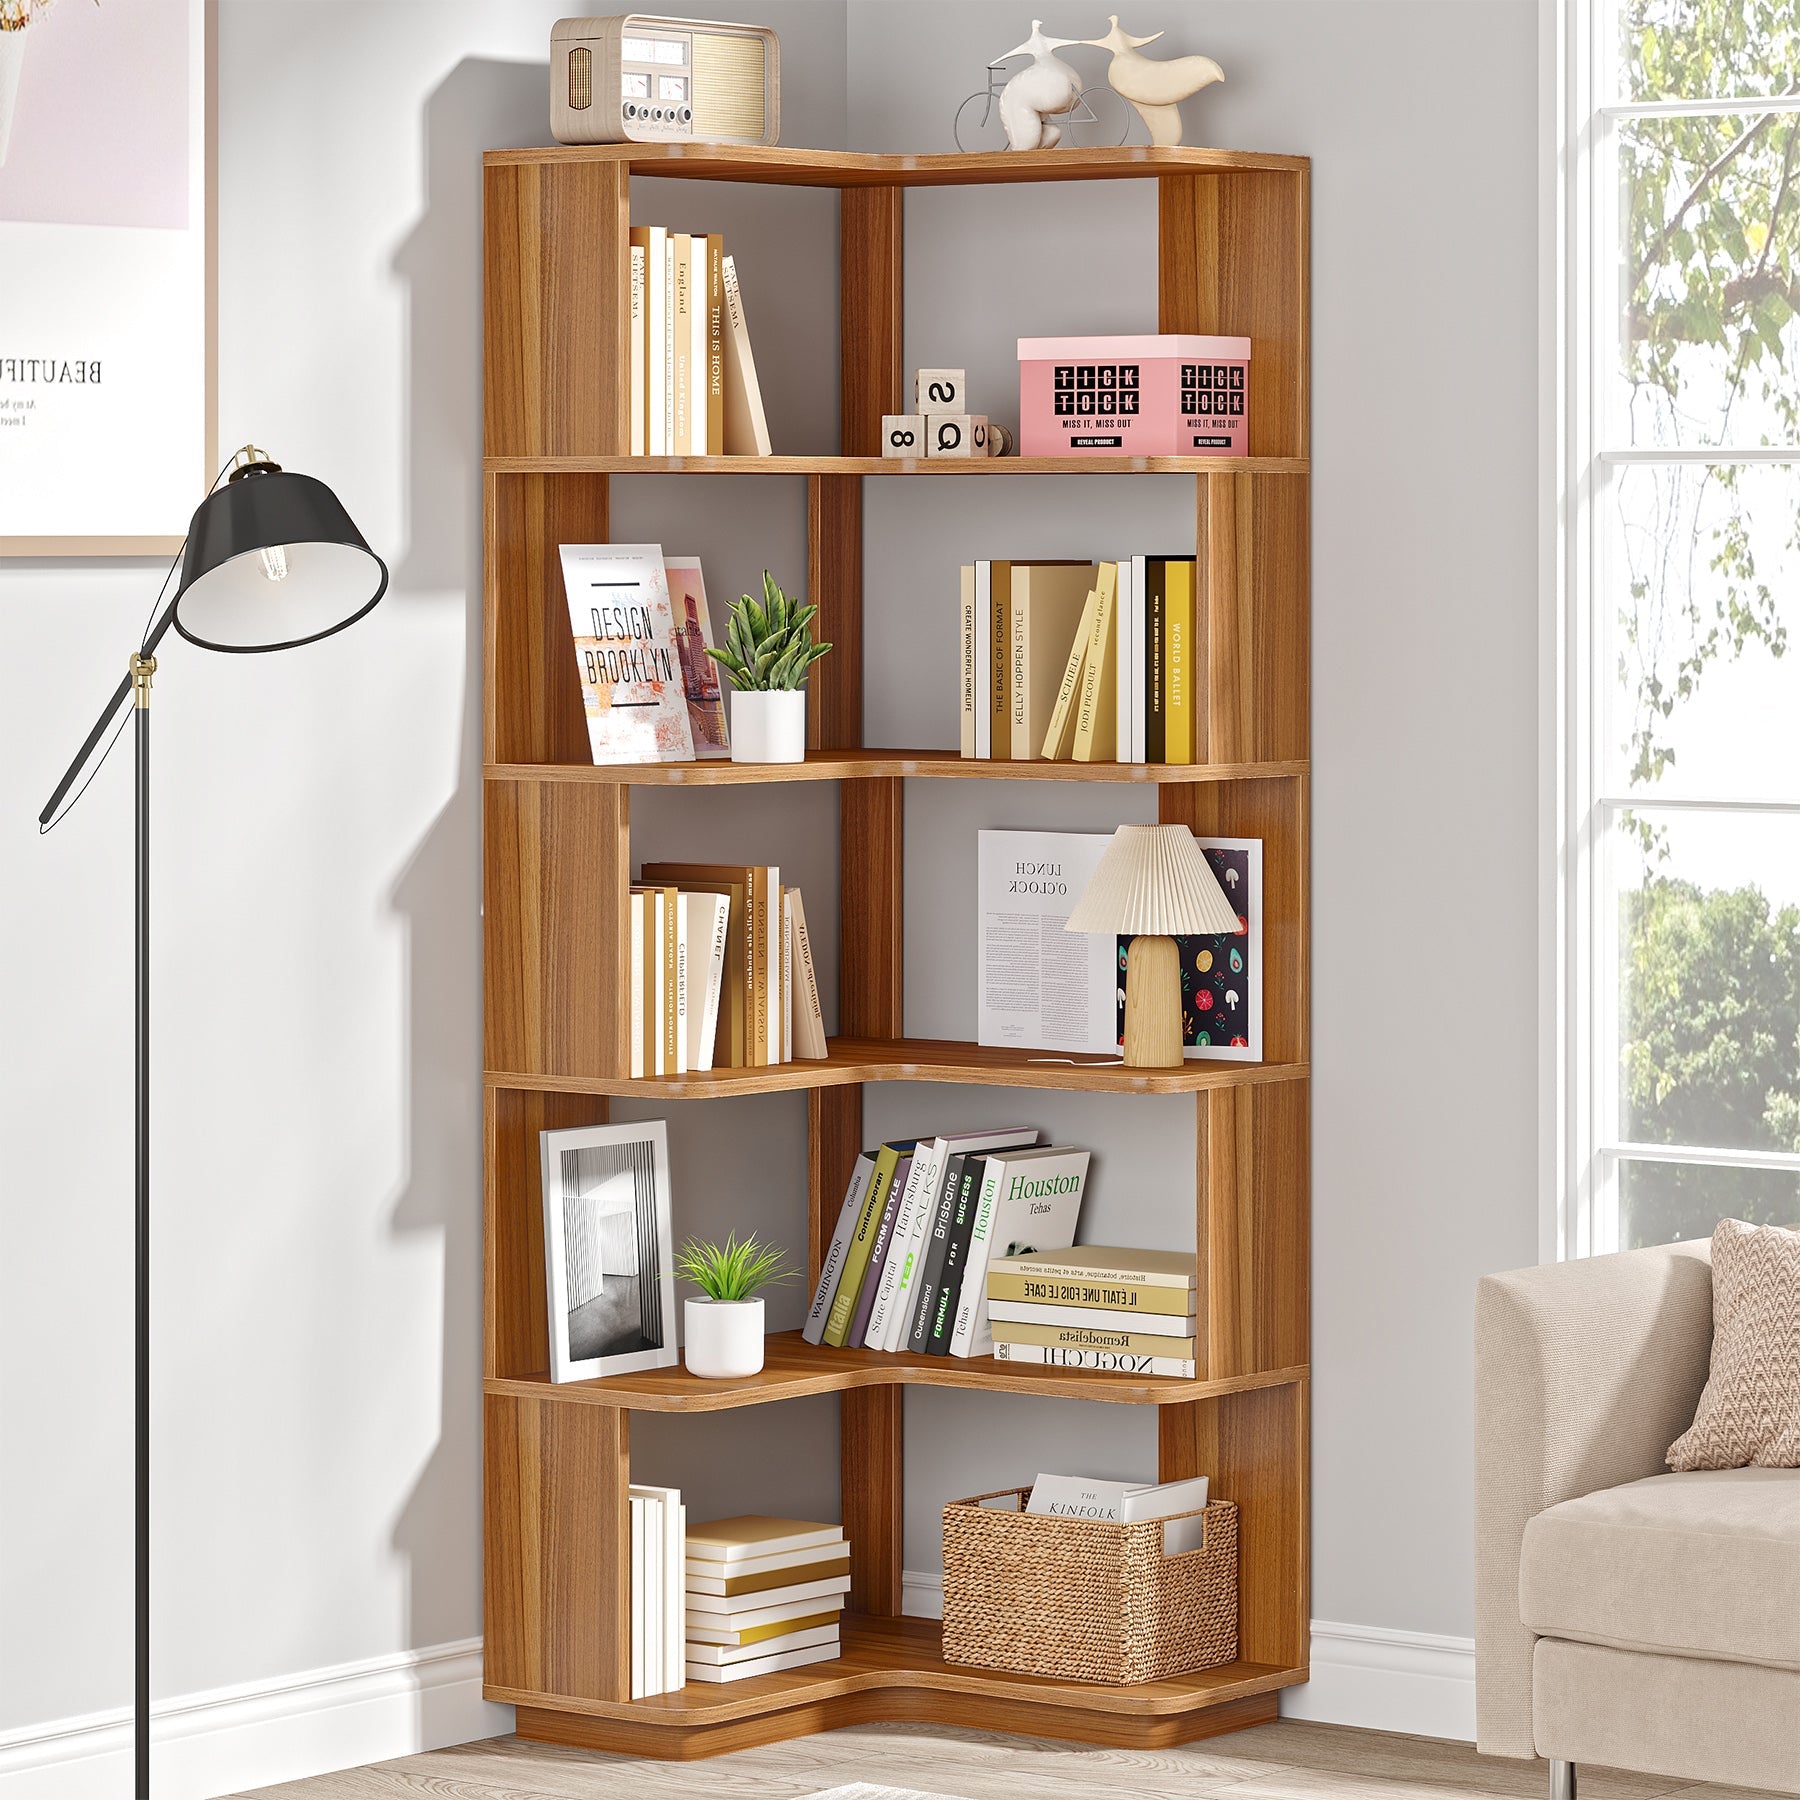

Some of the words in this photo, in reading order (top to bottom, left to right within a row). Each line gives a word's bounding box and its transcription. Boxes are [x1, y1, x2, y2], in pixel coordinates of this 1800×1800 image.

[677, 262, 687, 314] England
[711, 305, 720, 336] THIS
[711, 340, 720, 351] IS
[678, 355, 686, 390] United
[711, 354, 720, 395] HOME
[1059, 368, 1135, 387] TICK
[1185, 368, 1240, 387] TICK
[677, 392, 686, 437] Kingdom
[1059, 393, 1135, 412] TOCK
[1185, 393, 1240, 412] TOCK
[1062, 419, 1081, 429] MISS
[1083, 419, 1093, 429] IT,
[1095, 419, 1115, 428] MISS
[1117, 419, 1132, 428] OUT
[1187, 419, 1201, 428] MISS
[1202, 419, 1211, 429] IT,
[1211, 419, 1226, 429] MISS
[1077, 438, 1094, 446] REVEAL
[591, 606, 654, 642] DESIGN
[995, 602, 1004, 643] FORMAT
[1015, 609, 1024, 642] STYLE
[1093, 619, 1102, 646] second
[1098, 591, 1106, 617] glance
[995, 647, 1004, 660] OF
[1172, 623, 1181, 663] WORLD
[585, 648, 673, 684] BROOKLYN
[995, 663, 1004, 691] BASIC
[1015, 645, 1024, 689] HOPPEN
[1060, 654, 1081, 702] SCHIELE
[1084, 664, 1096, 707] PICOULT
[1172, 668, 1181, 706] BALLET
[995, 694, 1004, 714] THE
[1015, 693, 1024, 725] KELLY
[1080, 710, 1090, 733] JODI
[1008, 1174, 1080, 1201] Houston
[872, 1224, 888, 1264] FORM
[884, 1178, 901, 1221] STYLE
[1029, 1203, 1051, 1215] Tehas
[811, 1238, 843, 1319] WASHINGTON
[847, 1175, 862, 1208] Columbia
[827, 1294, 851, 1336] Italia
[857, 1172, 884, 1242] Contemporan
[872, 1306, 887, 1334] State
[881, 1261, 897, 1302] Capital
[895, 1160, 926, 1238] Harrisburg
[914, 1283, 932, 1339] Queensland
[934, 1172, 958, 1240] Brisbane
[933, 1287, 950, 1339] FORMULA
[948, 1242, 958, 1266] FOR
[956, 1174, 972, 1225] SUCCESS
[955, 1306, 970, 1336] Tehas
[973, 1179, 996, 1242] Houston
[900, 1252, 915, 1291] TED
[1049, 1503, 1117, 1520] KINFOLK
[1080, 1492, 1098, 1500] THE
